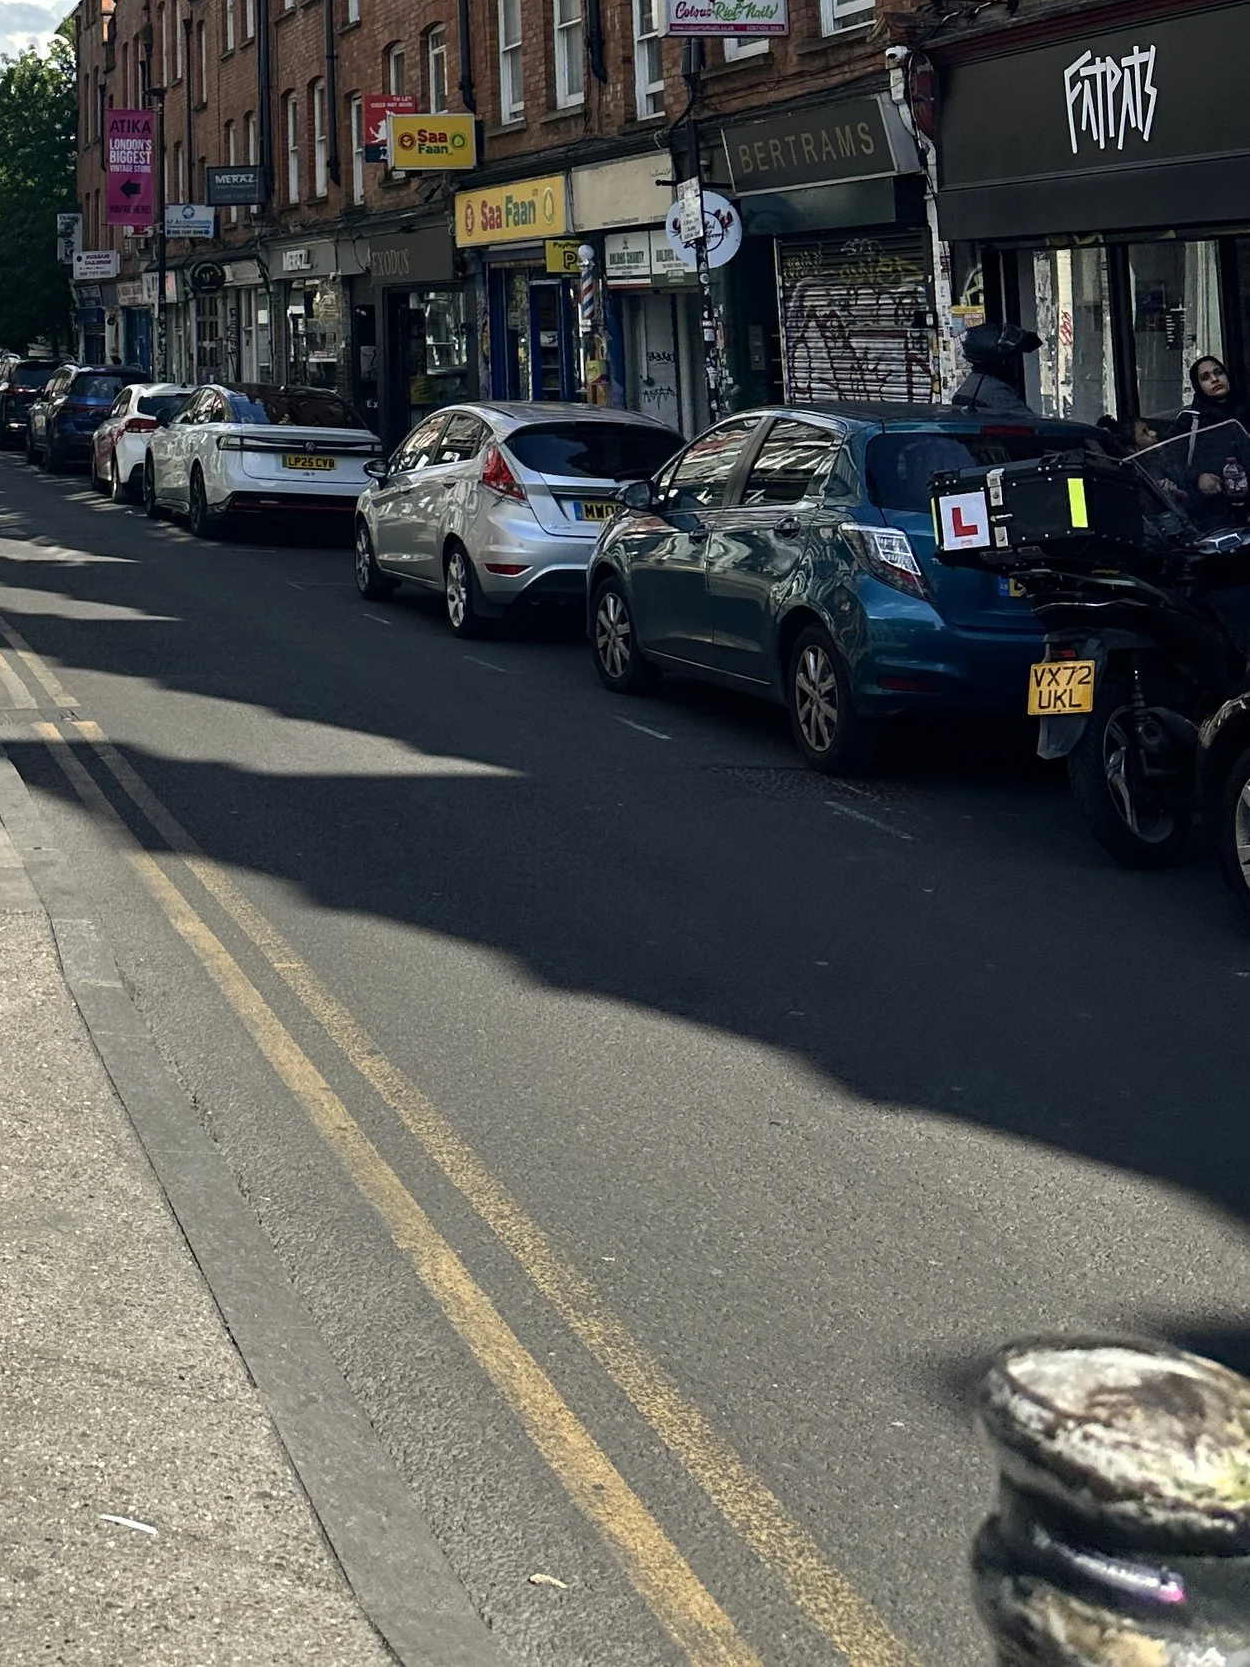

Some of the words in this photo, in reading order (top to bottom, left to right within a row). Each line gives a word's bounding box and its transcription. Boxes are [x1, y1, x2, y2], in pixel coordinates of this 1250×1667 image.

[110, 119, 152, 134] ATIKA
[110, 138, 152, 151] LONDON'S
[417, 129, 448, 143] Saa
[110, 150, 152, 164] BIGGEST
[418, 143, 449, 154] Faan
[738, 122, 875, 174] BERTRAMS
[480, 199, 503, 232] Saa
[505, 195, 537, 228] Faan
[371, 248, 410, 276] EXODUS
[288, 456, 314, 467] LP25
[952, 506, 979, 538] L
[1033, 665, 1092, 687] VX72
[1037, 689, 1083, 710] UKL
